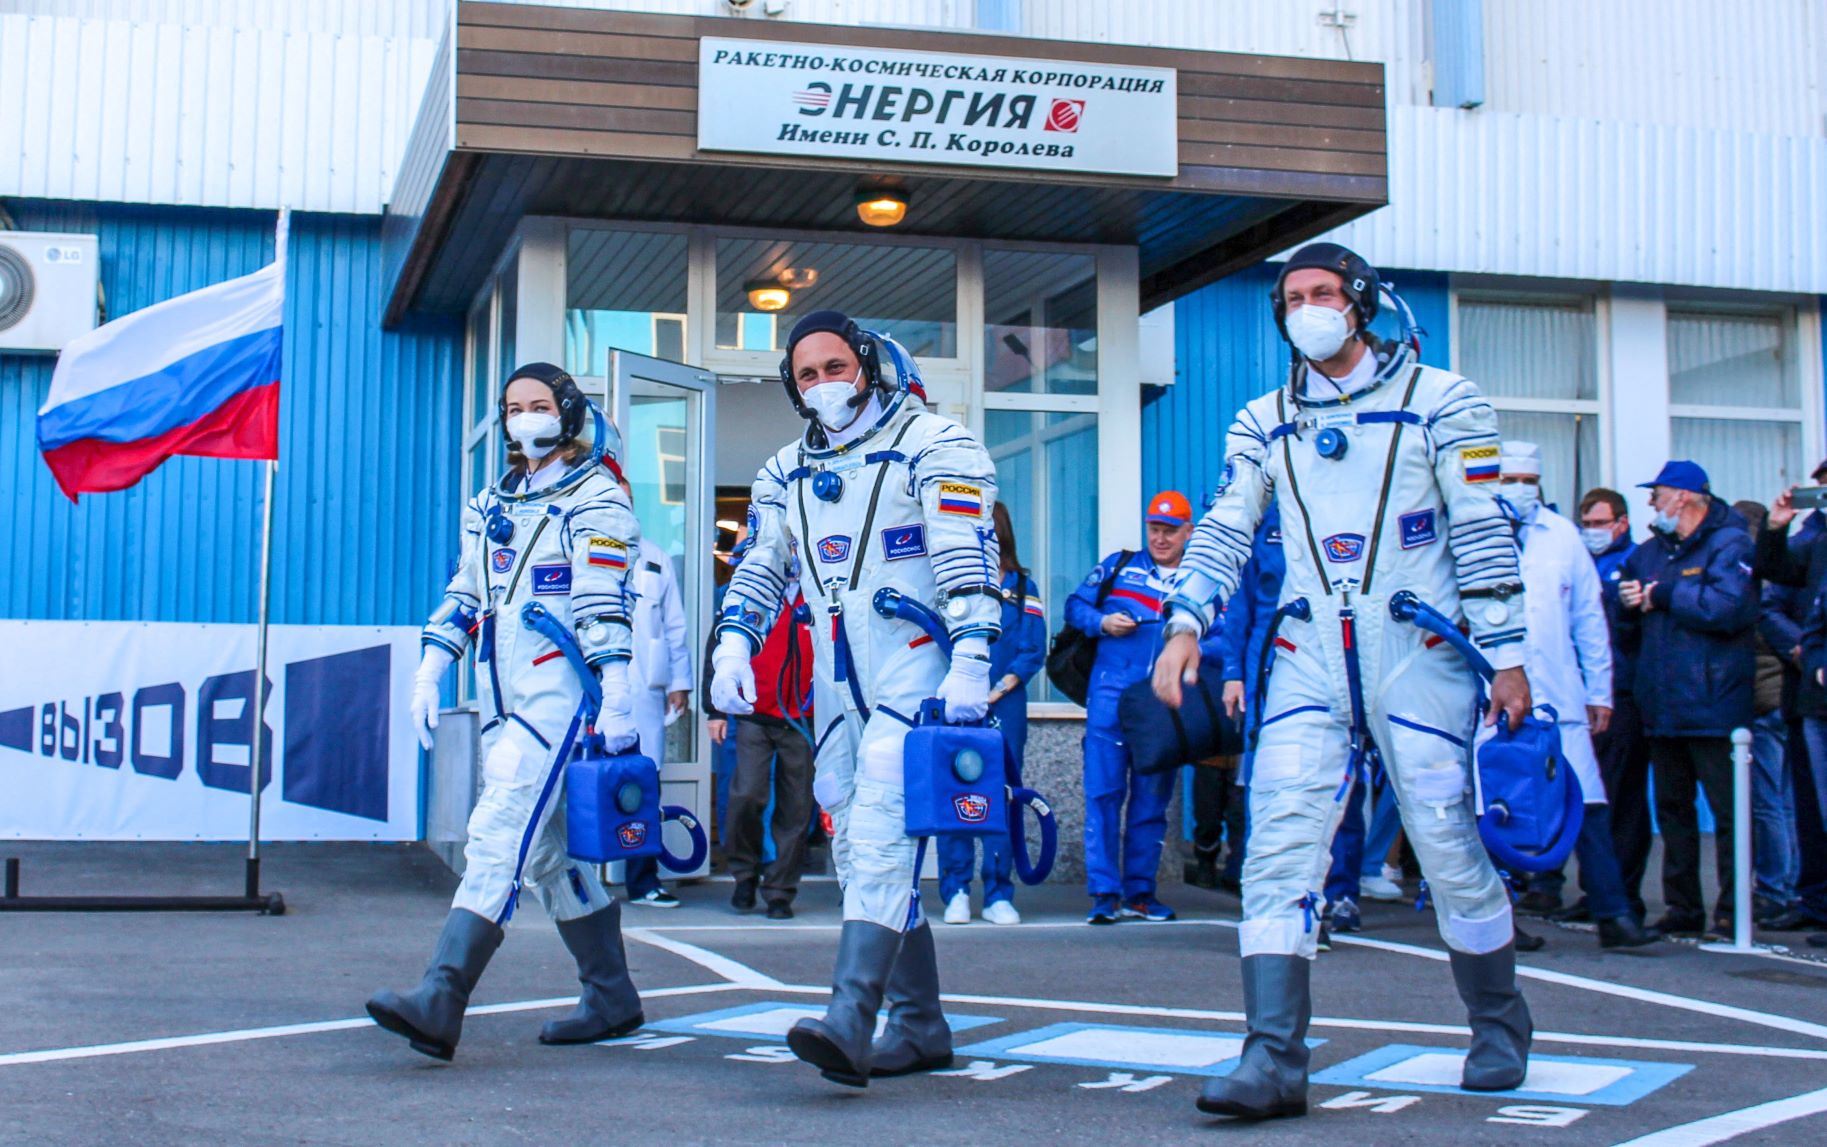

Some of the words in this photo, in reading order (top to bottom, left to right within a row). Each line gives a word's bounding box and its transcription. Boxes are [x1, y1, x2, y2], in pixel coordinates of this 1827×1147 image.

[713, 50, 1007, 84] РАКЕТНО-КОСМИЧЕСКАЯ
[1012, 69, 1164, 93] КОРПОРАЦИЯ
[795, 81, 1037, 129] ЭНЕРГИЯ
[776, 123, 869, 146] Имени
[876, 129, 901, 148] С.
[909, 131, 937, 150] П.
[945, 133, 1075, 158] Королева
[63, 250, 80, 260] LG
[941, 483, 980, 498] РОССИЯ
[40, 669, 274, 795] ВЫЗОВ
